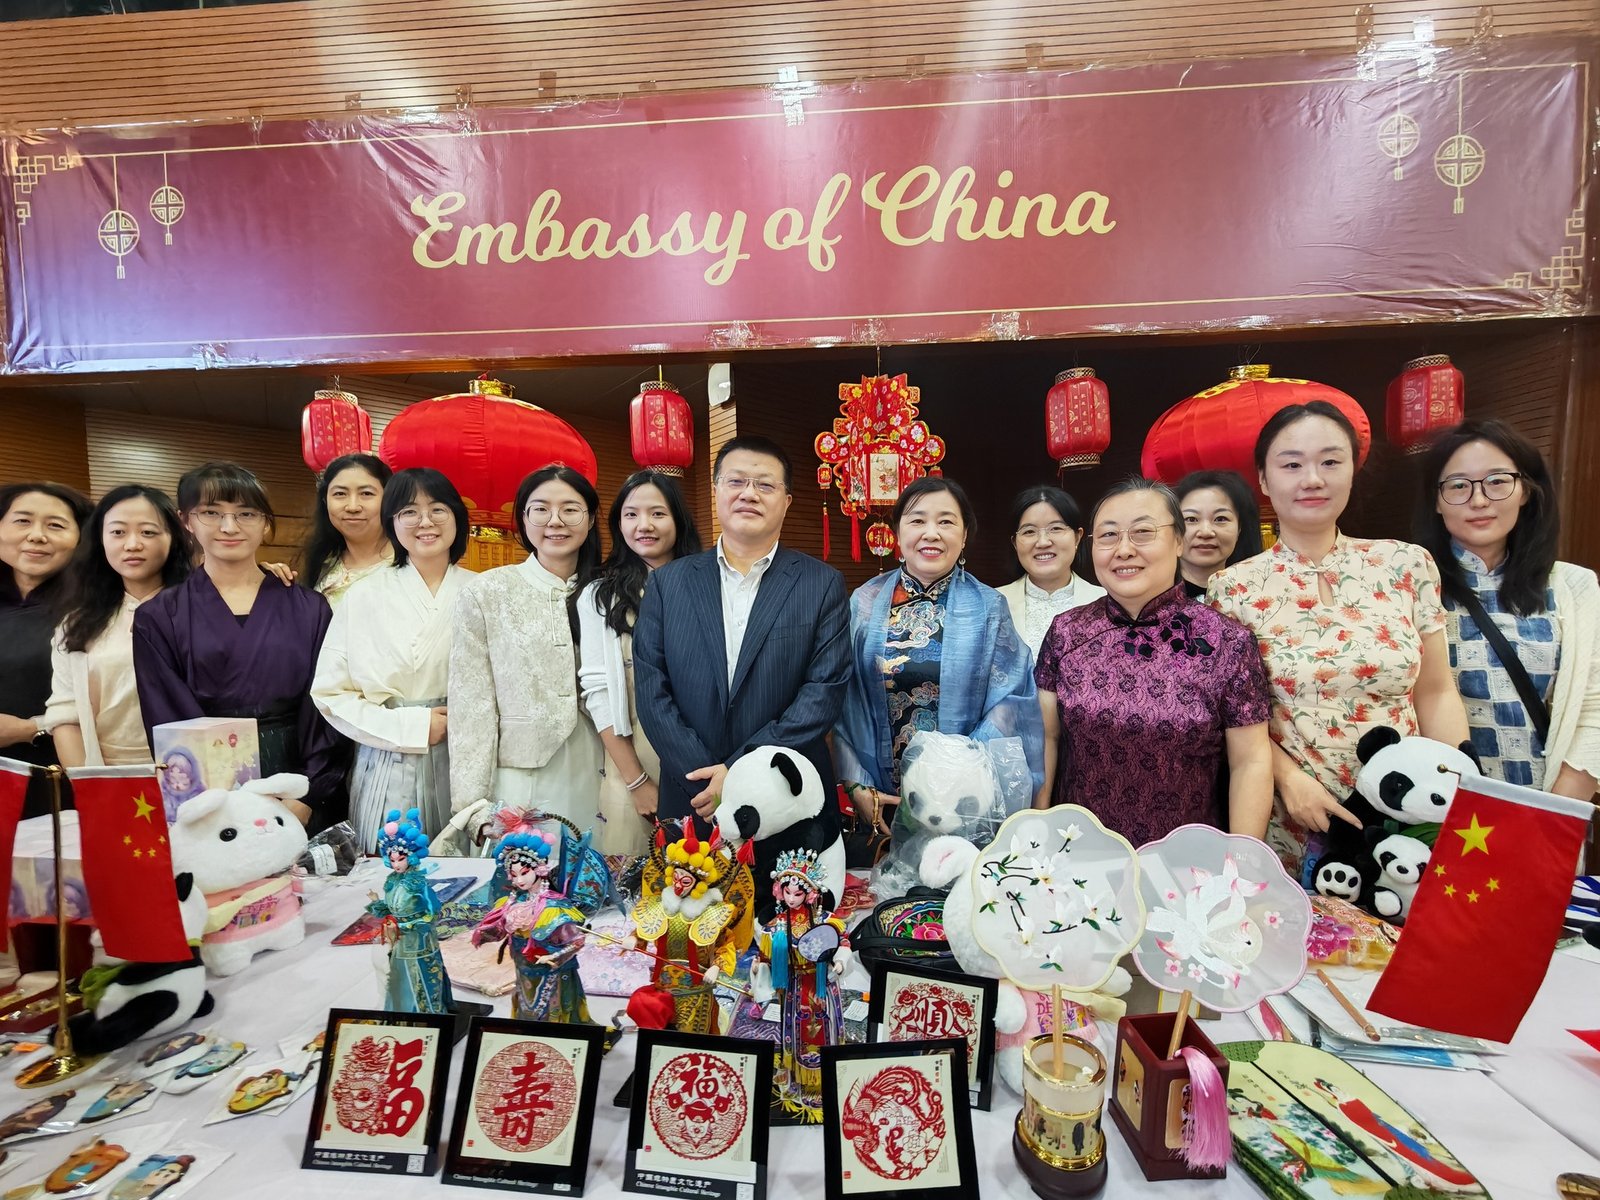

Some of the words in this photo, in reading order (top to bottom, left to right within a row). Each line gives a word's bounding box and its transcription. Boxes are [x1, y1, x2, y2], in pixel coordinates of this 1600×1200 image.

[410, 188, 750, 286] Embassy
[763, 172, 852, 273] of
[860, 164, 1117, 248] China
[679, 1054, 719, 1099] 福
